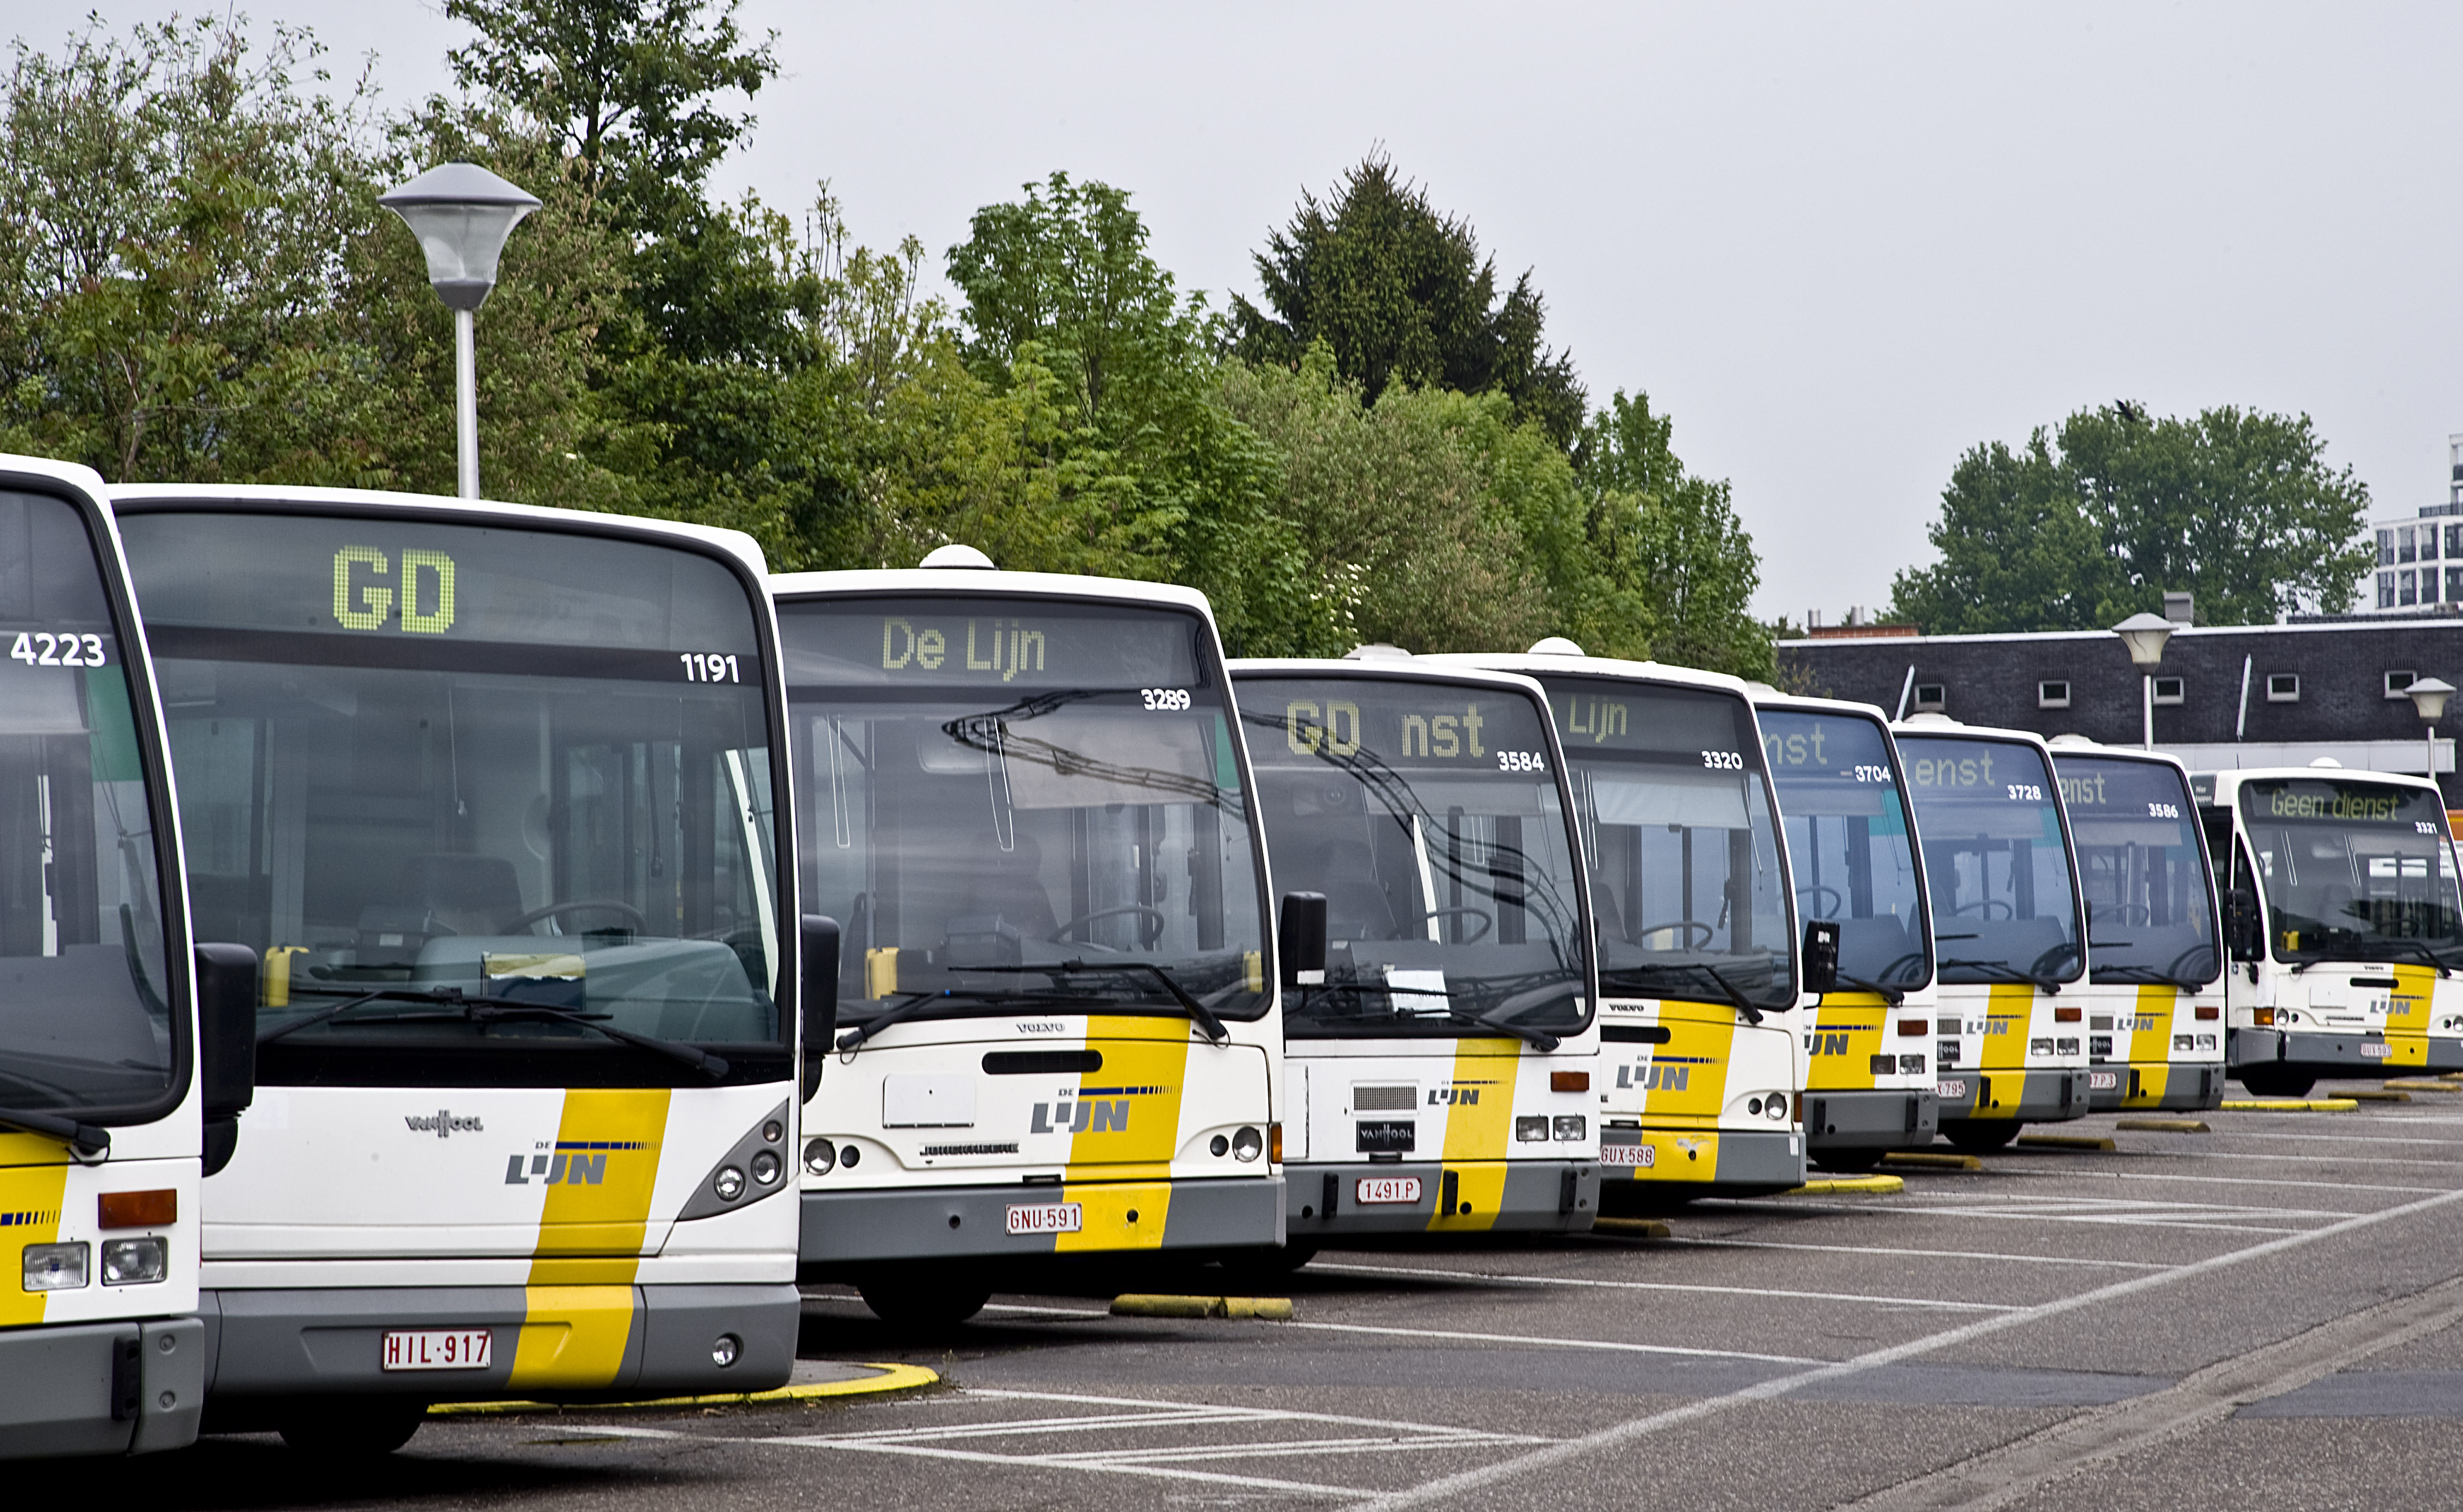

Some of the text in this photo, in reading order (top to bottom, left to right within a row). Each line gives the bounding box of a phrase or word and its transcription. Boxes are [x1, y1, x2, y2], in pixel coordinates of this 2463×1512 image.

[334, 545, 454, 634] GD
[10, 632, 105, 667] 4223
[884, 617, 1044, 682] De Lijn
[681, 653, 739, 684] 1191
[1141, 688, 1191, 711] 3289
[1287, 699, 1485, 758] GD nst
[1570, 695, 1627, 743] Lijn
[1497, 751, 1544, 772] 3584
[1701, 751, 1743, 770] 3320
[1855, 765, 1891, 782] 3704
[2007, 785, 2042, 800] 3728
[2148, 803, 2179, 818] 3586
[2272, 788, 2398, 821] Geen dienst
[2370, 1000, 2411, 1015] LIJN
[1016, 1023, 1065, 1033] VOLVO
[1966, 1020, 2009, 1035] LIJN
[2117, 1018, 2154, 1031] LIJN
[1616, 1065, 1689, 1091] LIJN
[1058, 1088, 1074, 1096] DE
[1427, 1089, 1479, 1105] LIJN
[1030, 1100, 1130, 1134] LIJN
[536, 1141, 552, 1149] DE
[505, 1154, 607, 1185] LIJN
